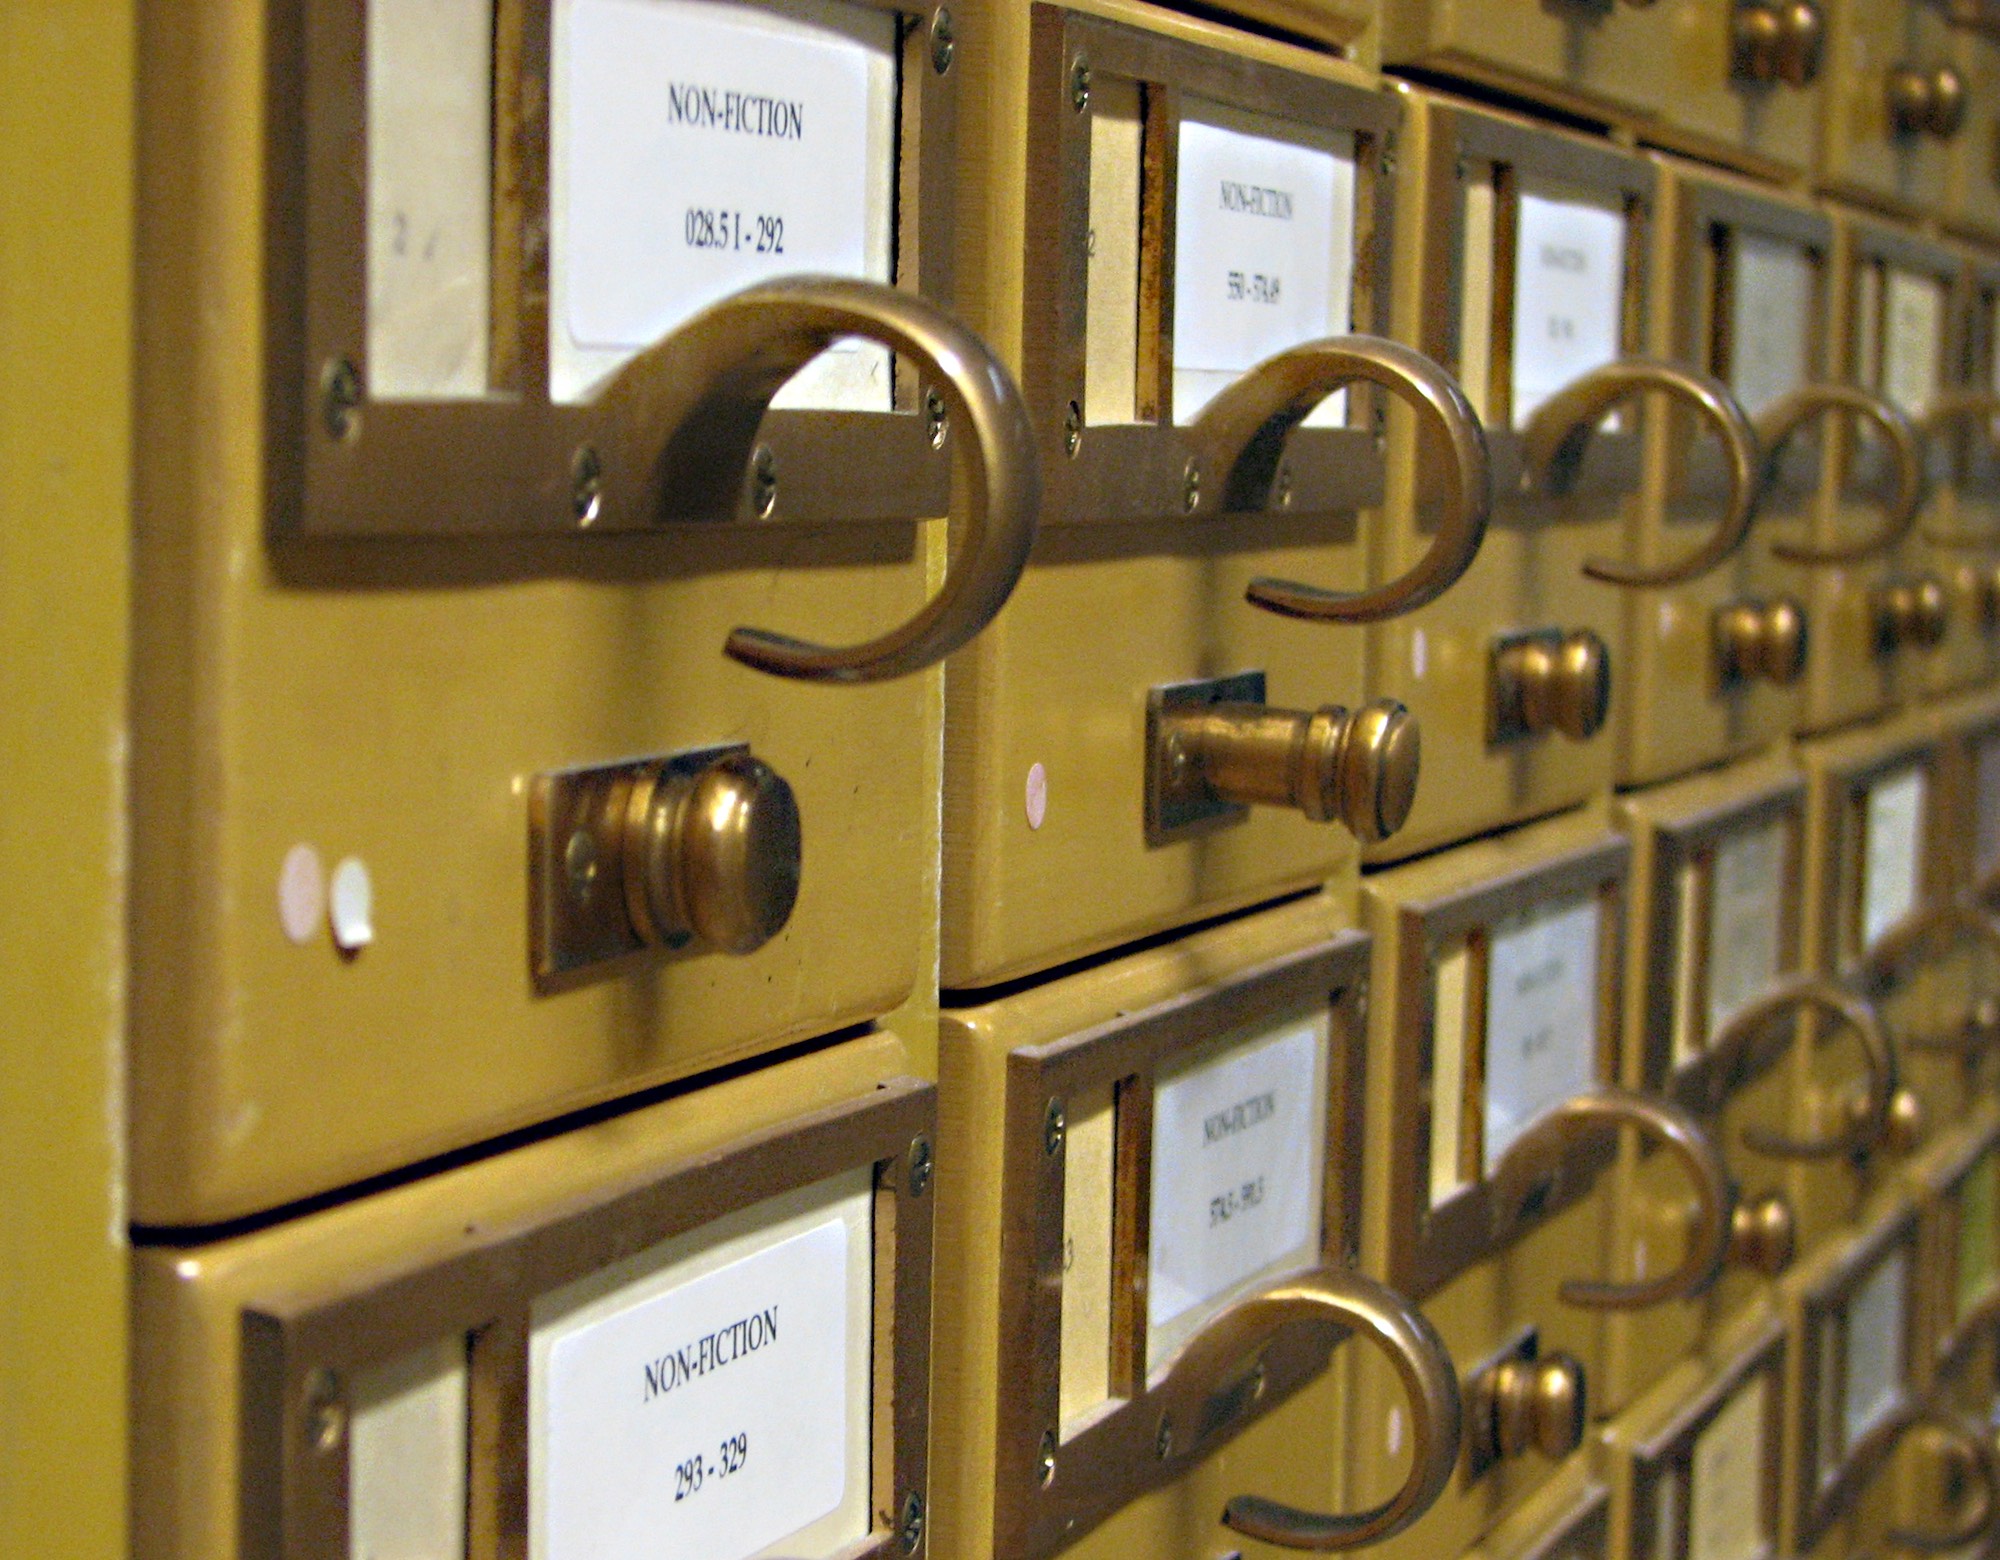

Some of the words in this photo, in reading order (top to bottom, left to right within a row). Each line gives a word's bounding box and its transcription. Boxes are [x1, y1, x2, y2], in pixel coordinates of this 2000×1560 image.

[668, 81, 804, 140] NON-FICTION
[755, 213, 785, 254] 292
[643, 1304, 779, 1404] NON-FICTION
[673, 1454, 704, 1502] 293
[718, 1432, 748, 1481] 329
